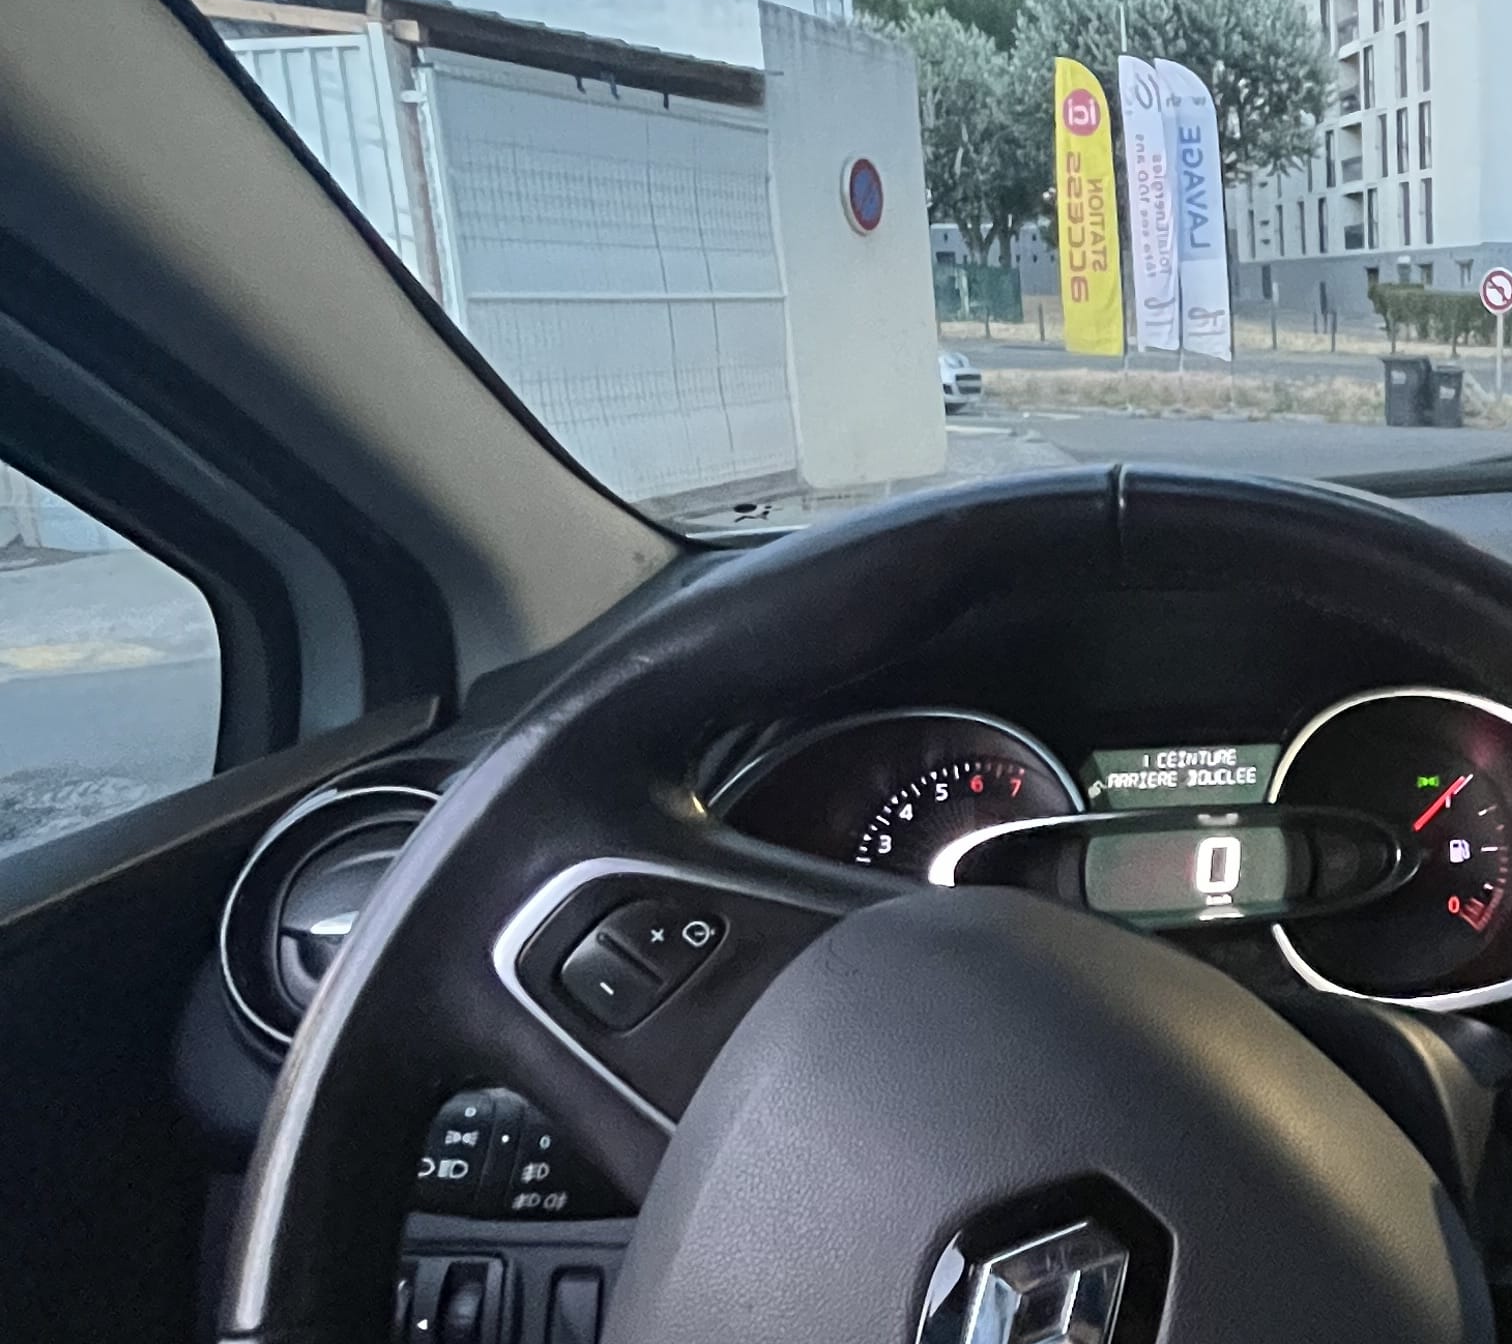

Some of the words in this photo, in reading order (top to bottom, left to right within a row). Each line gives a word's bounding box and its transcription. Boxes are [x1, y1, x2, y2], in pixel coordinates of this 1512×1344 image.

[1156, 749, 1237, 768] CEINTURE
[969, 775, 984, 793] 6
[1010, 778, 1023, 797] 7
[1107, 769, 1179, 789] ARRIERE
[935, 783, 949, 802] 5
[898, 803, 914, 821] 4
[877, 834, 893, 854] 3
[1195, 836, 1242, 894] 0
